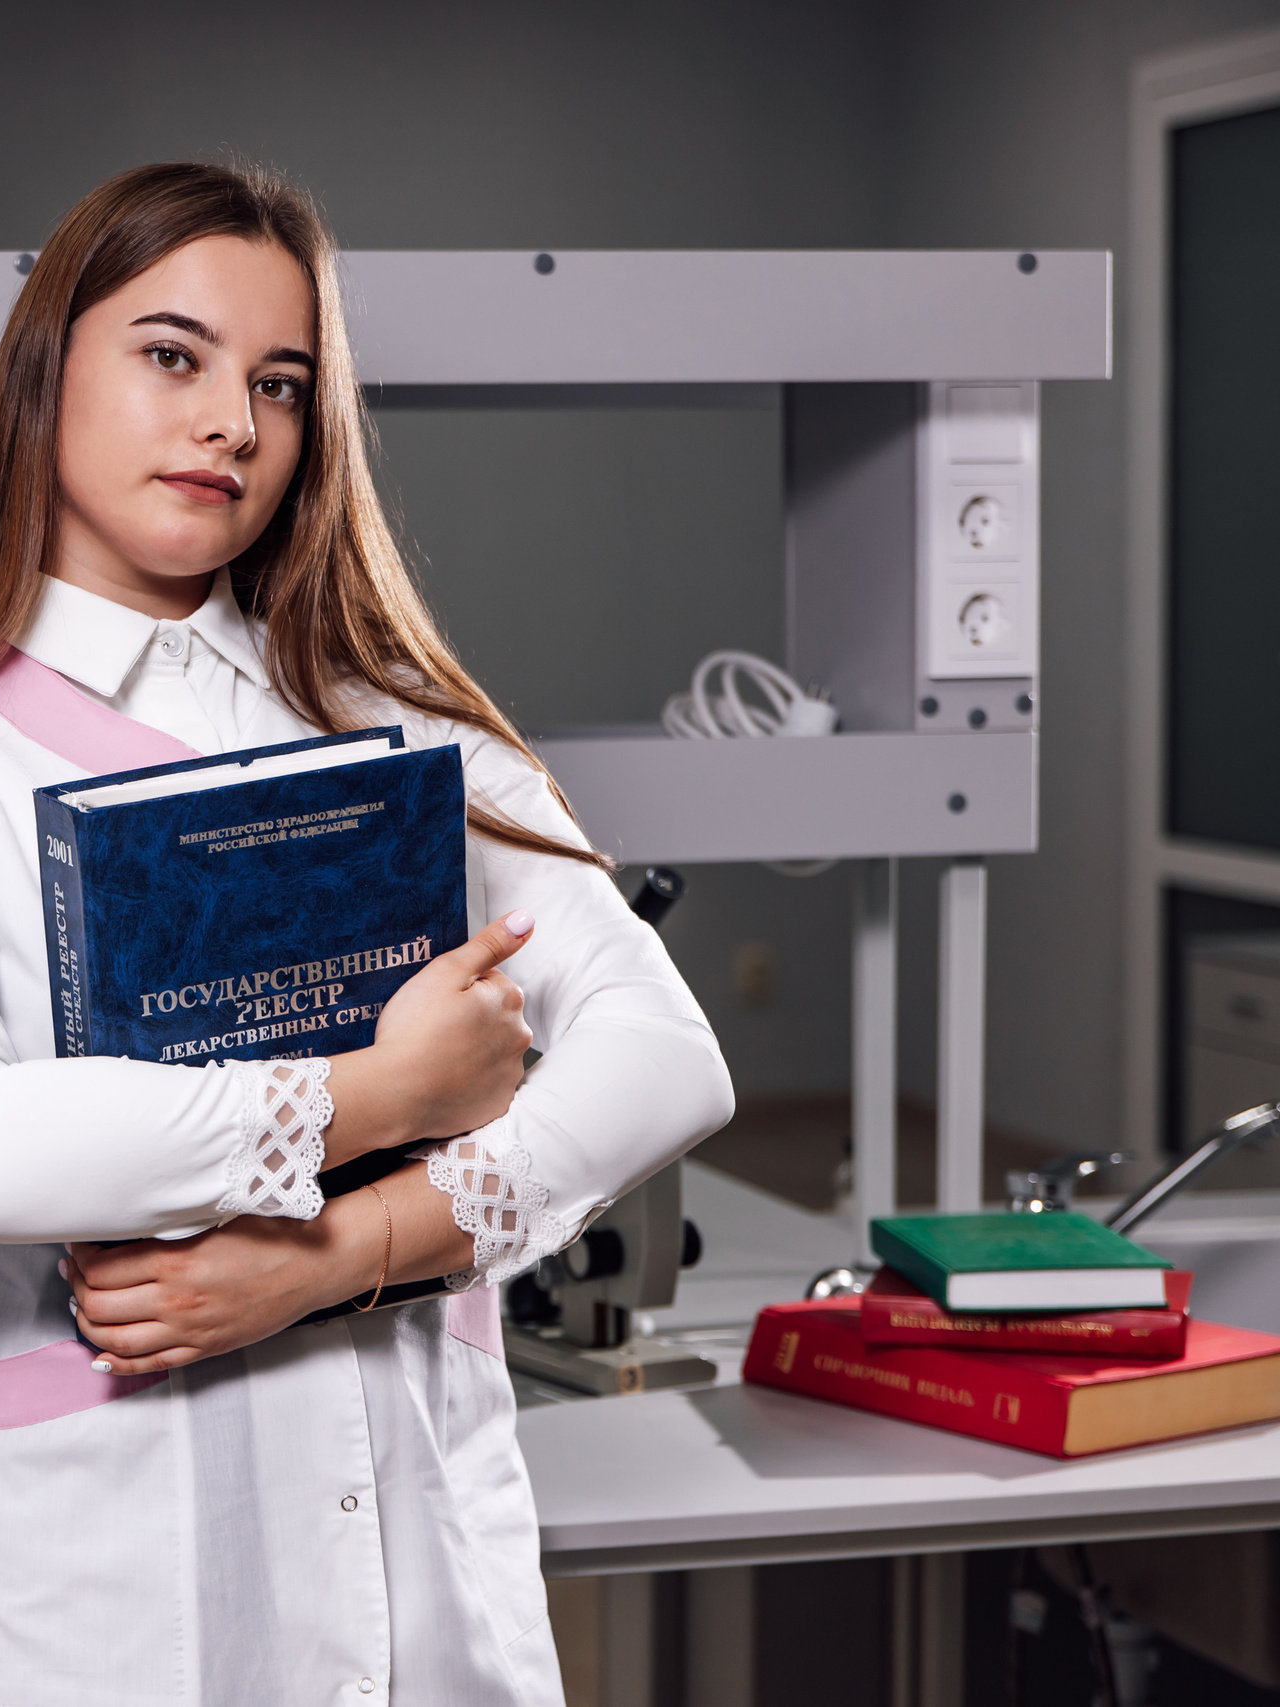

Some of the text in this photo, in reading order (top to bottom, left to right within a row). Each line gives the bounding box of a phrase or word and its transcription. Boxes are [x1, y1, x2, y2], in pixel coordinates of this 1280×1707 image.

[179, 801, 385, 845] МИНИСТЕРСТВО ЗДРАВООХРАНЕНИЯ
[208, 818, 359, 853] РОССИЙСКОЙ ФЕДЕРАЦИИ
[46, 834, 74, 868] 2001
[54, 881, 71, 983] РЕЕСТР
[70, 949, 84, 1034] СРЕДСТВ
[140, 935, 432, 1017] ГОСУДАРСТВЕННЫЙ
[235, 983, 344, 1024] РЕЕСТР
[159, 1013, 330, 1062] ЛЕКАРСТВЕННЫХ
